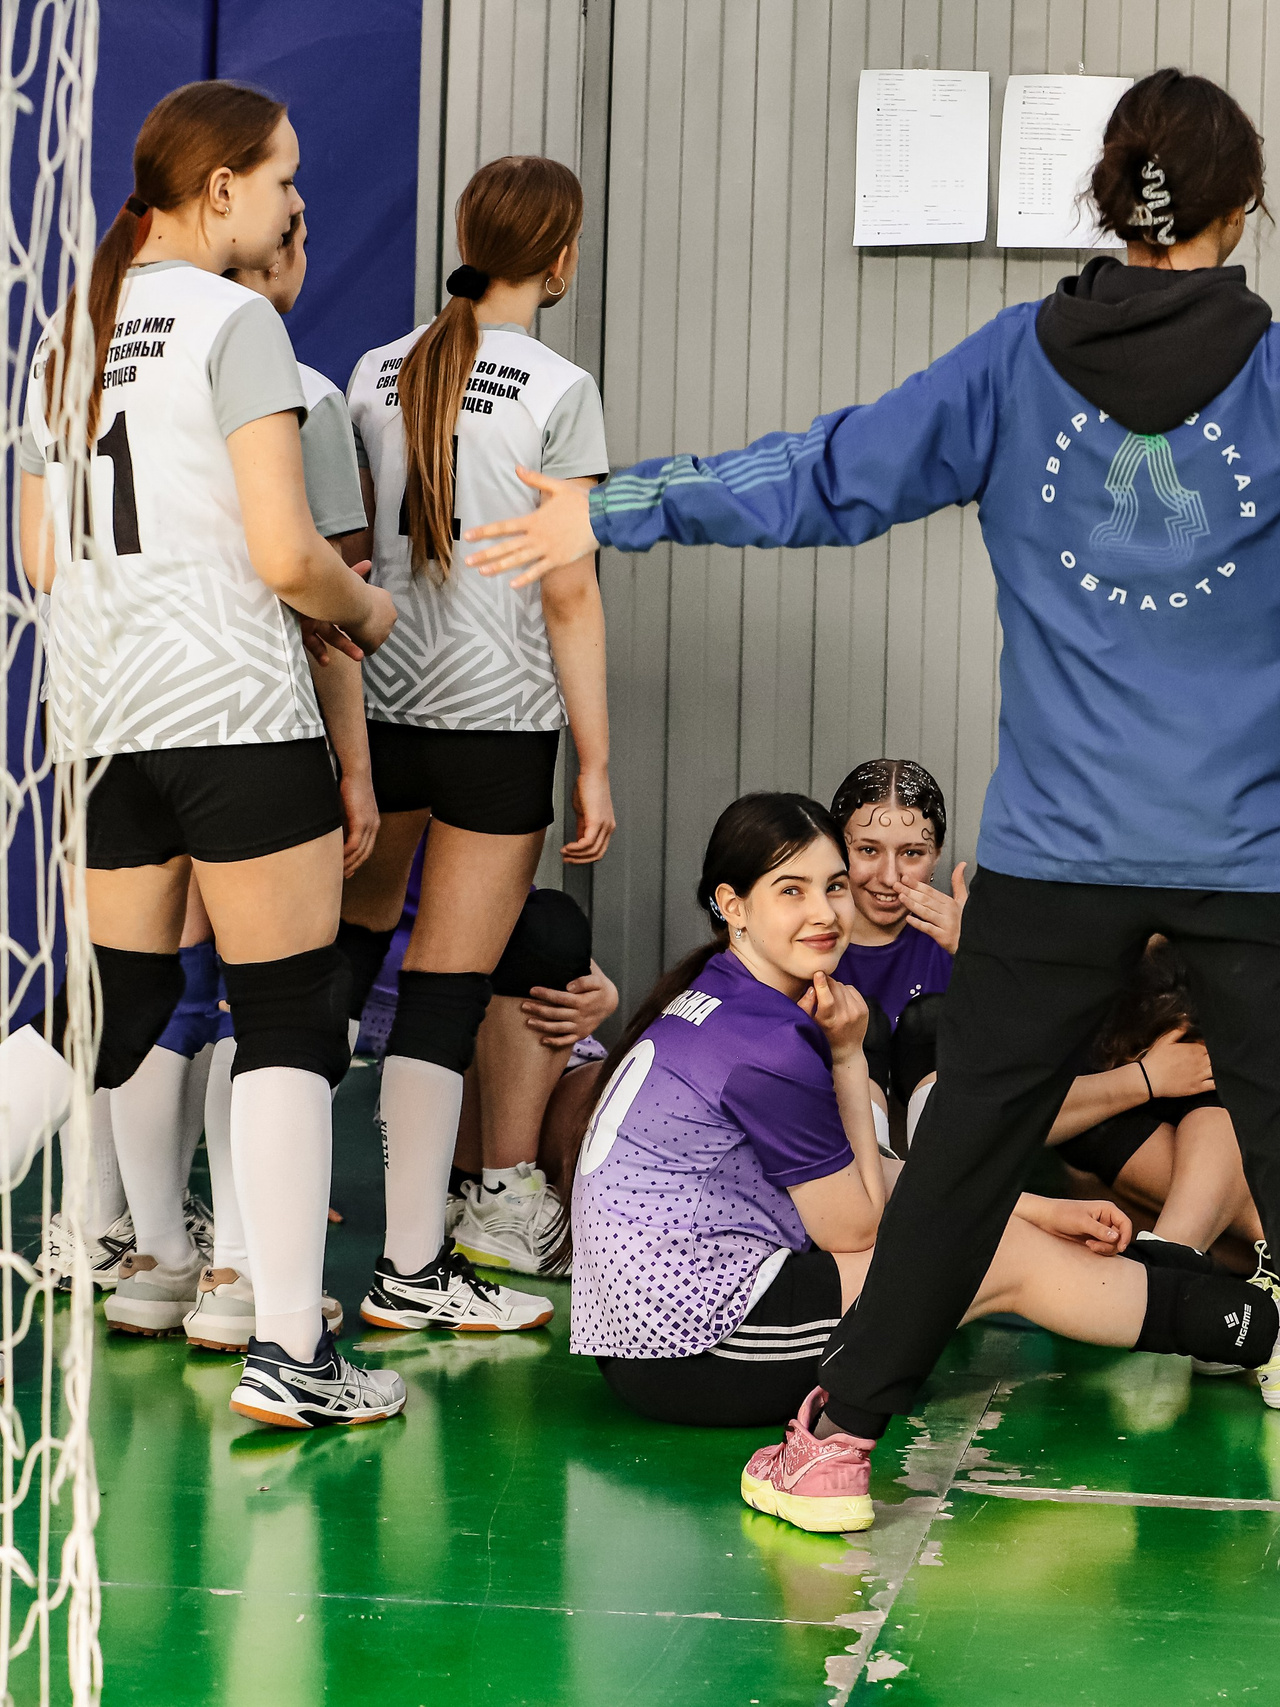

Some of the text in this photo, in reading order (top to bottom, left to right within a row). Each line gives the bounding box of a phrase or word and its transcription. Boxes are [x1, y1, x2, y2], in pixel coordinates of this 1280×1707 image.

[124, 318, 141, 336] ВО
[142, 317, 176, 334] ИМЯ
[106, 341, 166, 364] ТВЕННЫХ
[476, 360, 497, 375] ВО
[497, 365, 531, 386] ИМЯ
[1061, 550, 1236, 611] ОБЛАСТЬ
[1235, 1303, 1252, 1347] INGAME
